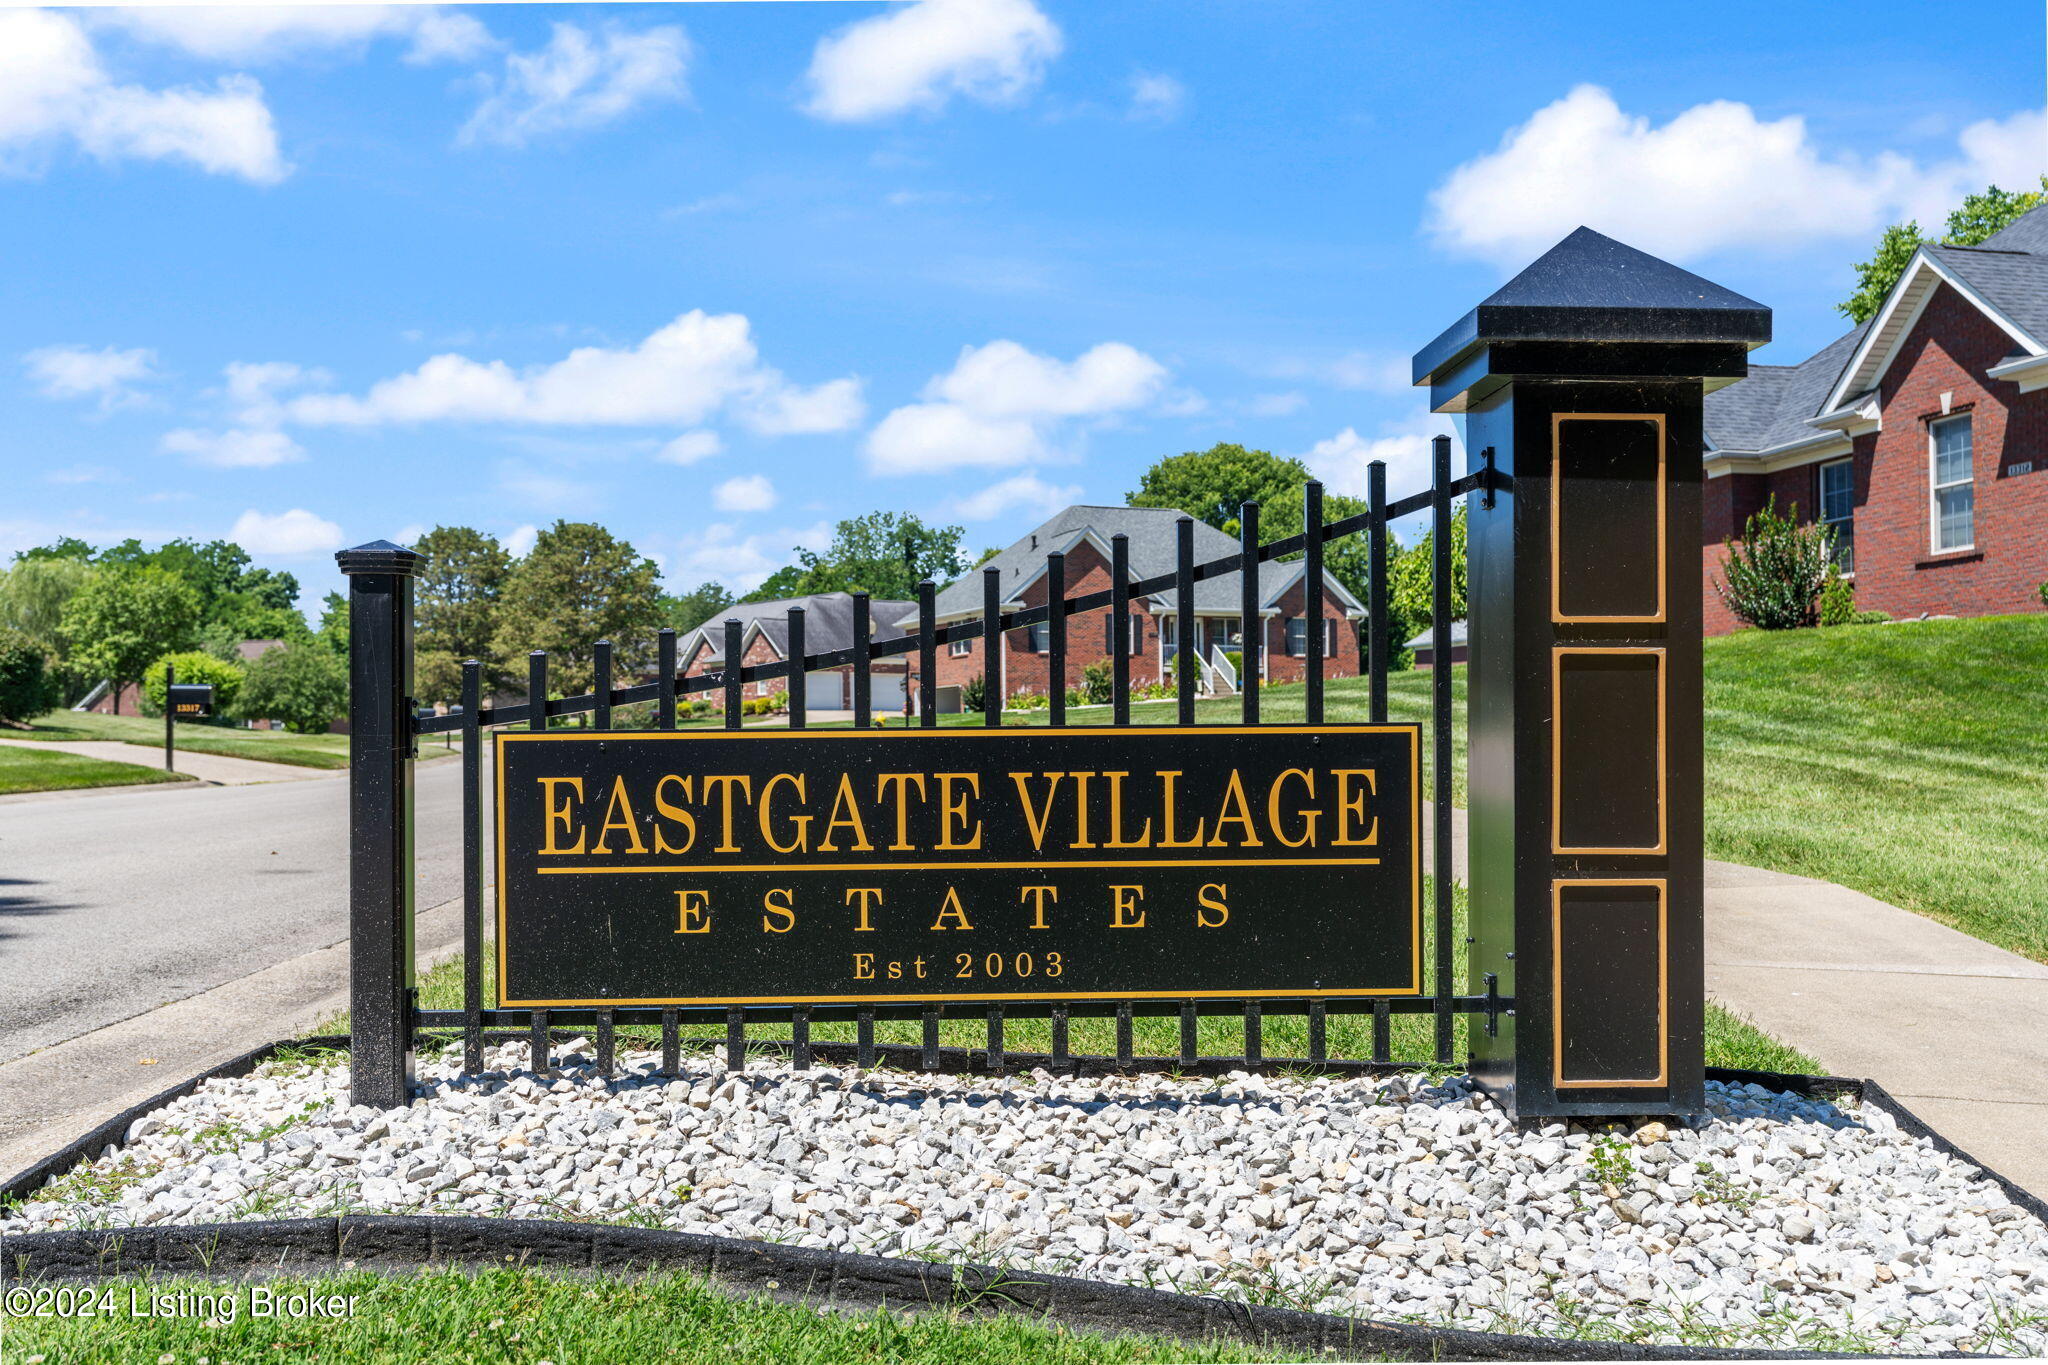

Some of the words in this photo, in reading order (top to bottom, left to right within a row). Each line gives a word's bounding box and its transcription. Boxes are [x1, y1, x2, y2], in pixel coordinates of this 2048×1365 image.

[537, 772, 982, 855] EASTGATE
[1008, 768, 1378, 848] VILLAGE
[673, 883, 1229, 934] ESTATES
[852, 953, 926, 980] Est
[955, 951, 1063, 978] 2003
